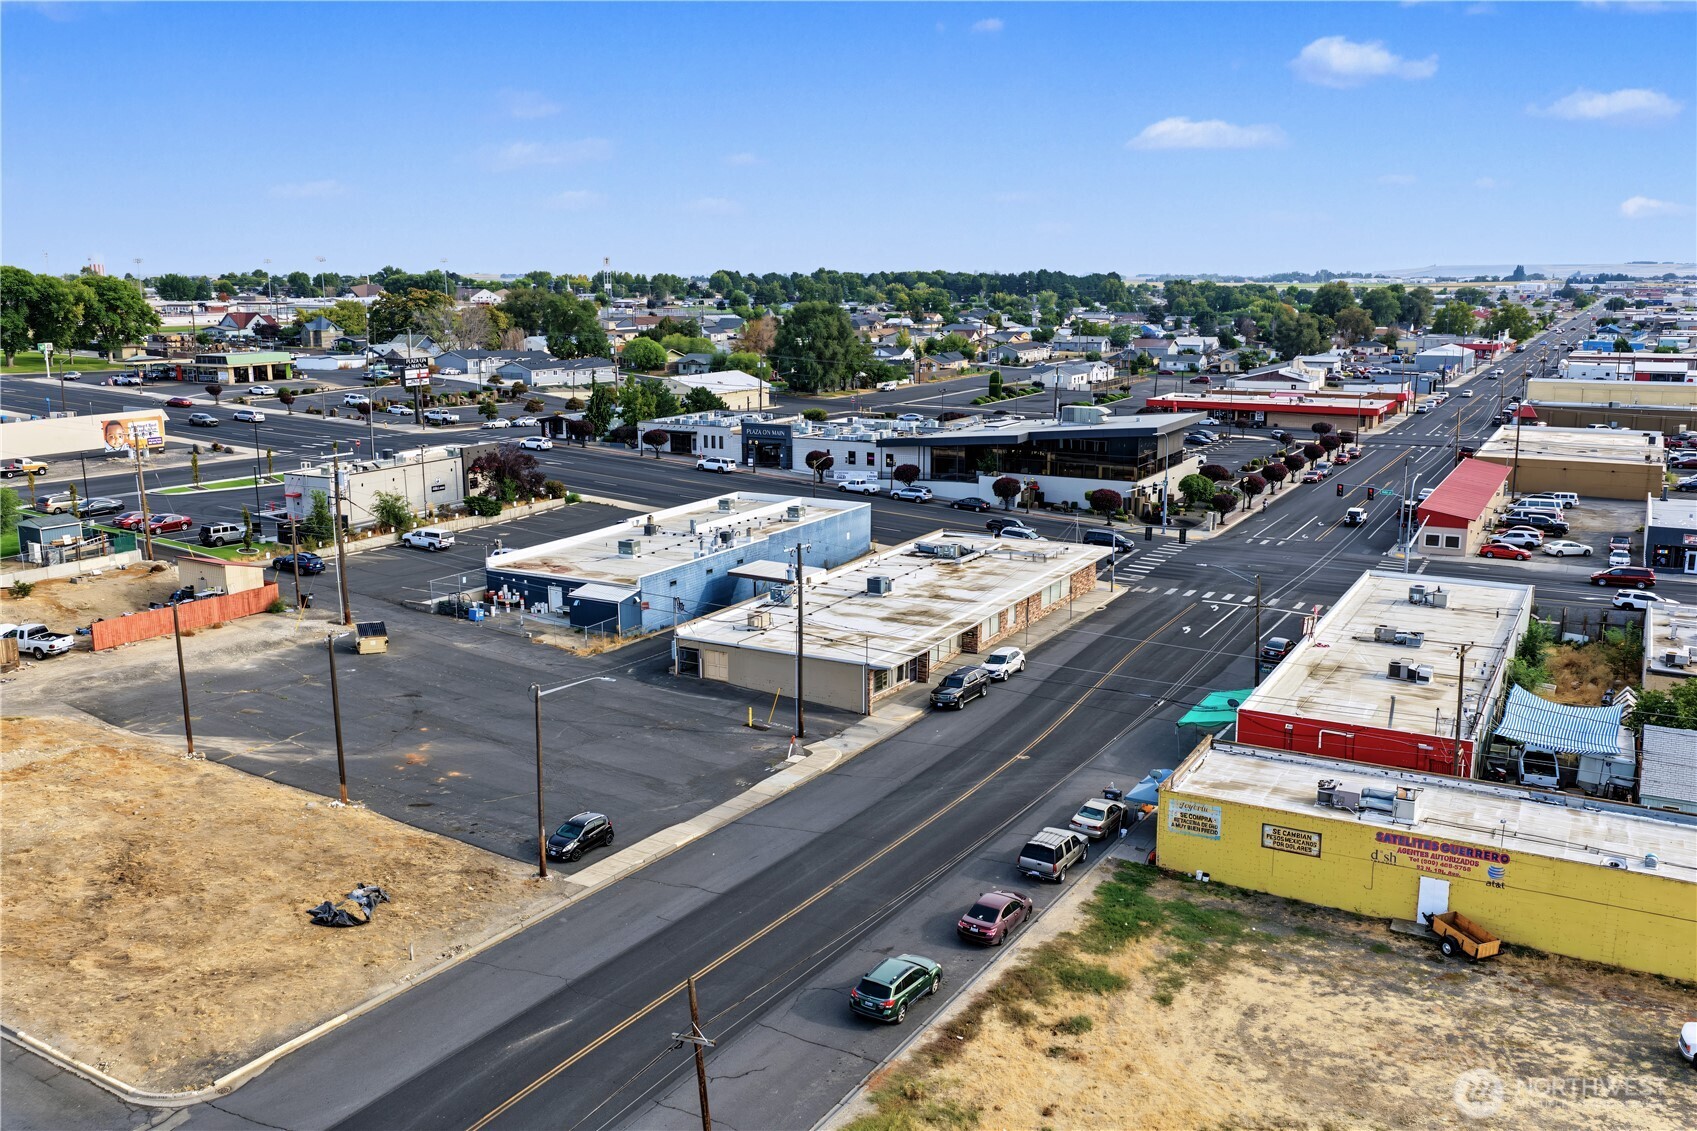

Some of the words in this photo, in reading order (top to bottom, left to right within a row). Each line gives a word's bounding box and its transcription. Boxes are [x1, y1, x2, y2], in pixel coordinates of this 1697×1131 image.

[1188, 813, 1212, 823] COMPRA
[1266, 833, 1284, 841] PESOS
[1284, 837, 1317, 848] MEXICANOS
[1282, 830, 1312, 841] CAMBIAN
[1284, 842, 1312, 852] DOLARES
[1375, 831, 1440, 851] SATELITES
[1440, 842, 1510, 864] GUERRERO
[1370, 849, 1397, 863] dsh
[1397, 847, 1430, 858] AGENTES
[1430, 853, 1479, 867] AUTORIZADOS
[1485, 880, 1506, 889] at&t
